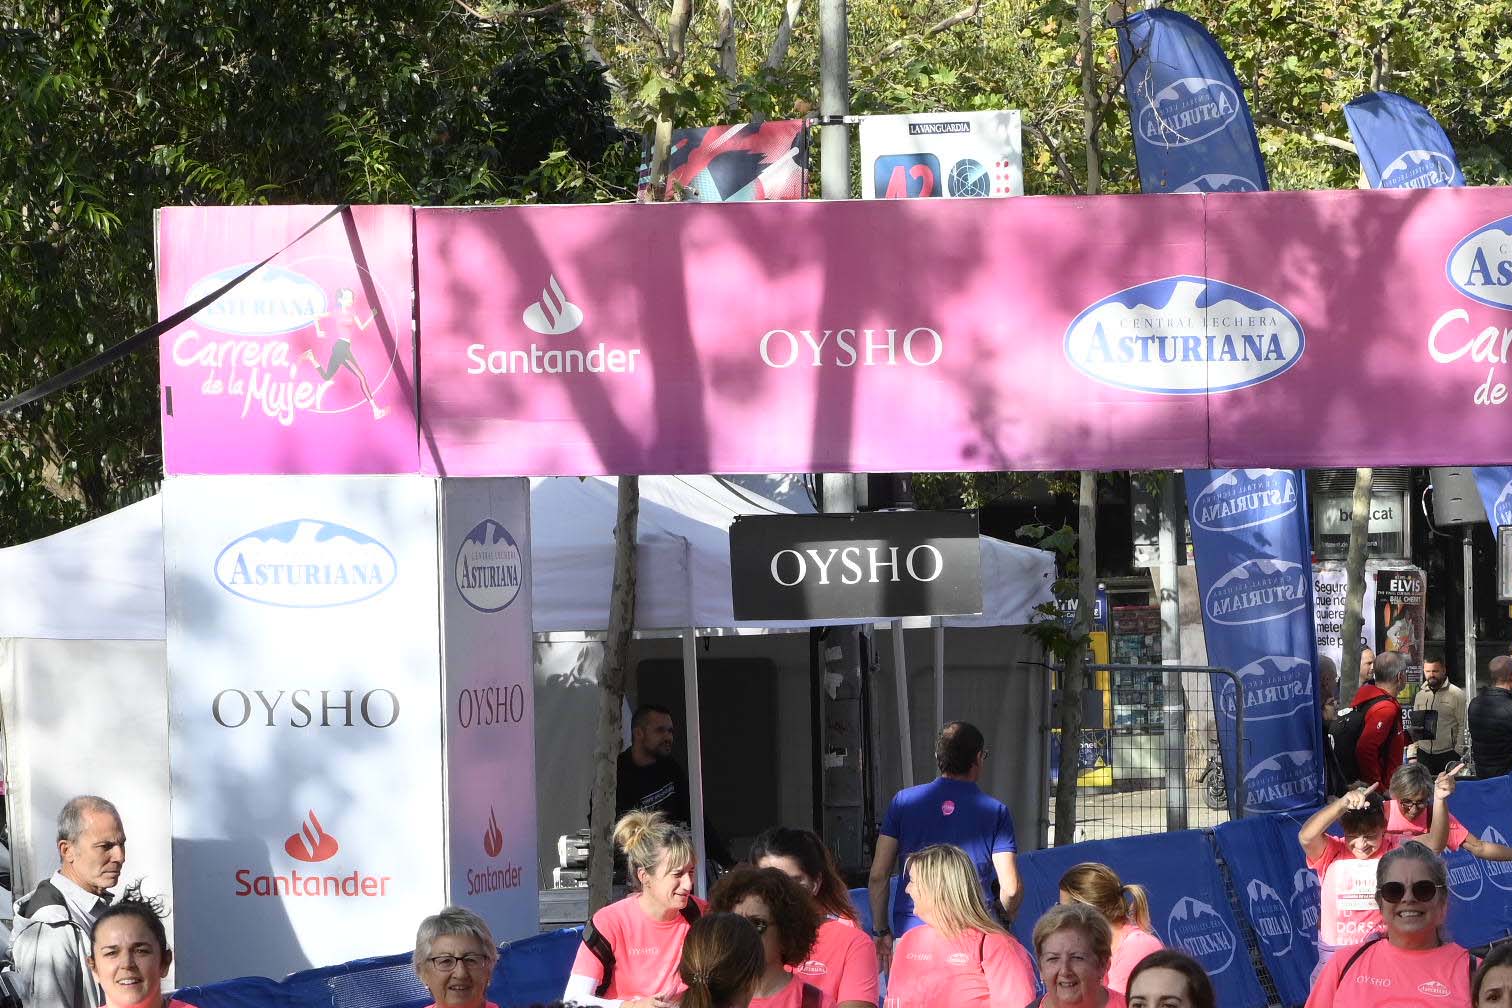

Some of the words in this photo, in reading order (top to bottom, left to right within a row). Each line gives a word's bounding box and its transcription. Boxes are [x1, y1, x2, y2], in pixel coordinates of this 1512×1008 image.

[1119, 316, 1195, 330] CENTRAL
[172, 329, 290, 368] Carrera
[467, 342, 640, 376] Santander
[758, 326, 944, 369] OYSHO
[1086, 320, 1286, 364] ASTURIANA
[202, 368, 224, 395] de
[228, 367, 245, 397] la
[241, 361, 335, 427] Mujer
[1473, 367, 1508, 406] de
[229, 552, 383, 587] ASTURIANA
[461, 555, 519, 588] ASTURIANA
[770, 544, 944, 587] OYSHO
[1315, 596, 1331, 609] que
[1390, 579, 1422, 593] ELVIS
[1317, 637, 1336, 647] este
[211, 687, 400, 729] OYSHO
[458, 684, 525, 729] OYSHO
[235, 869, 391, 898] Santander
[467, 866, 522, 897] Santander
